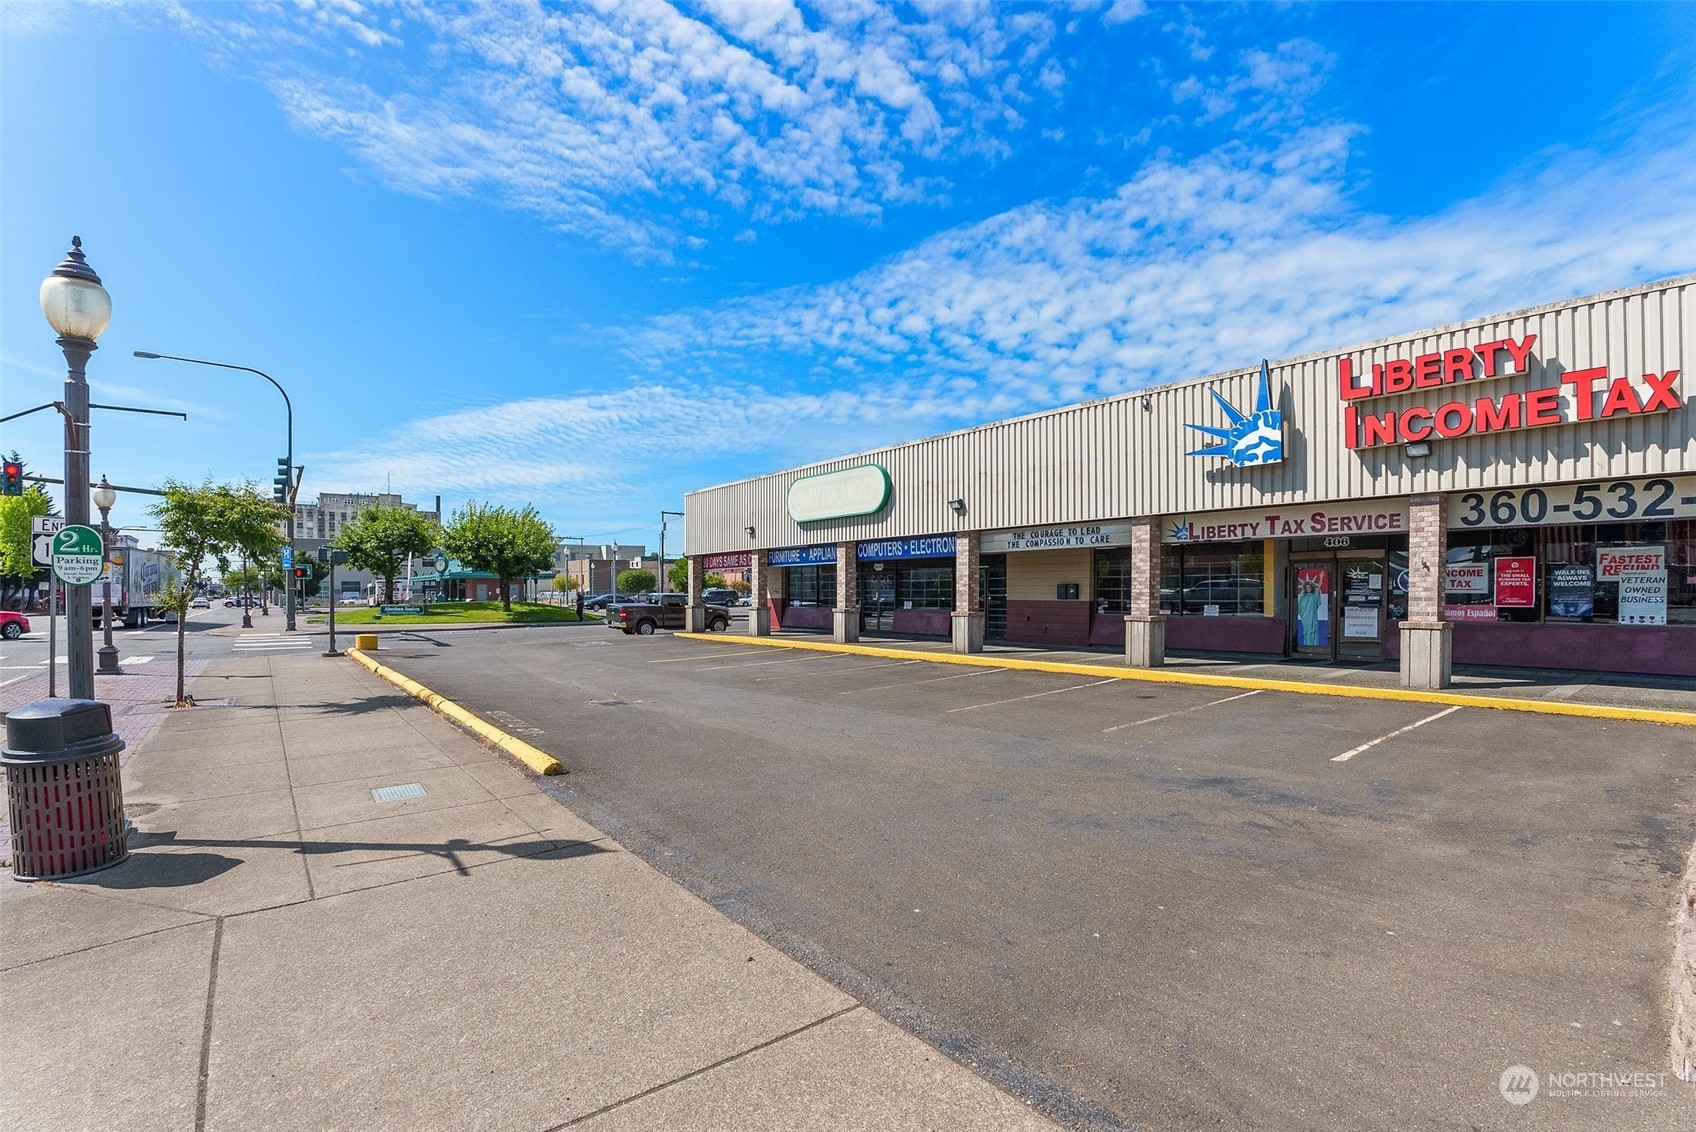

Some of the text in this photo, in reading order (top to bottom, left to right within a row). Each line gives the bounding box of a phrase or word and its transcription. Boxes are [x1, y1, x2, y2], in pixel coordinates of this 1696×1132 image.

[1340, 334, 1538, 401] LIBERTY
[1345, 366, 1681, 449] INCOME TAX
[1031, 529, 1063, 538] COURAGE
[1068, 528, 1078, 536] TO
[1081, 526, 1100, 535] LEAD
[1188, 512, 1402, 541] LIBERTY TAX SERVICE
[60, 531, 80, 552] 2
[1007, 535, 1110, 549] THE COMPASSION TO CARE
[1324, 537, 1350, 547] 406
[858, 541, 903, 557] COMPUTERS
[57, 557, 100, 566] Parking
[710, 556, 723, 567] DAYS
[724, 555, 738, 567] SAME
[739, 554, 748, 566] AS
[769, 549, 800, 564] FURNITURE
[1599, 553, 1662, 564] FASTEST
[1445, 569, 1484, 577] NCOME
[1449, 580, 1472, 588] TAX
[1621, 576, 1666, 584] VETERAN
[1467, 608, 1496, 618] Español
